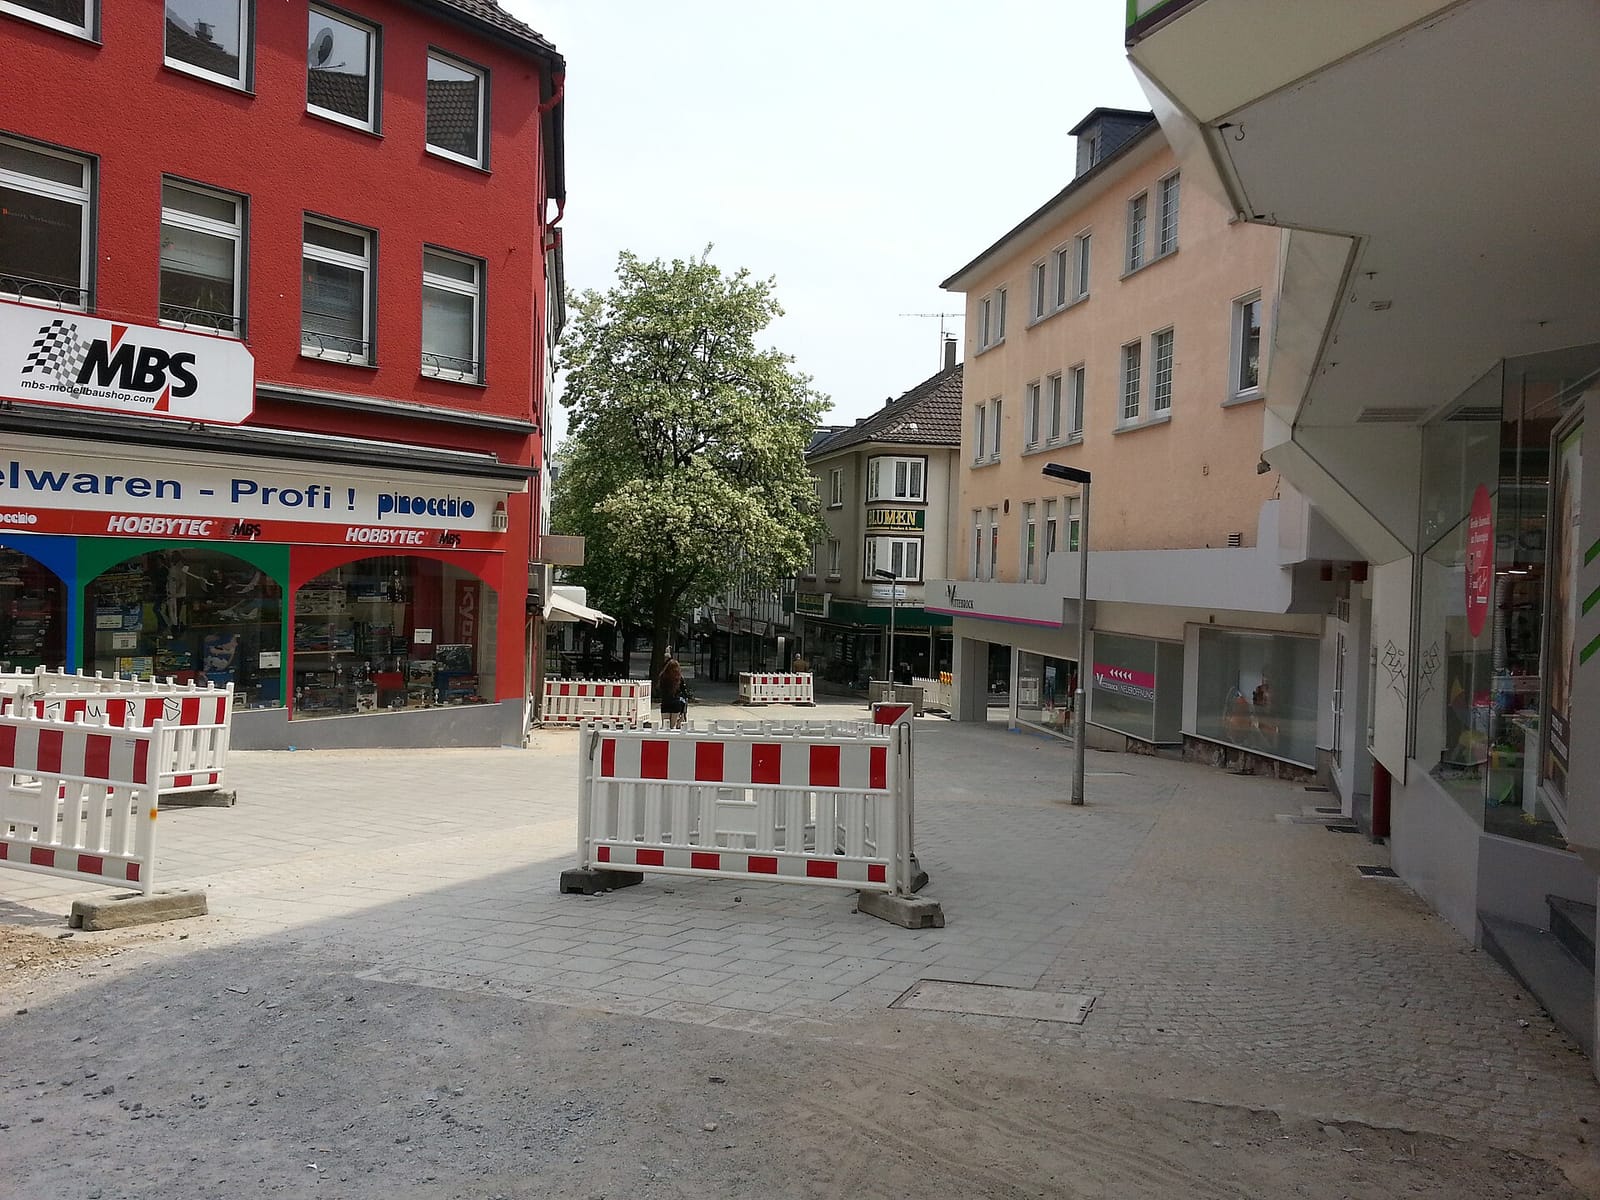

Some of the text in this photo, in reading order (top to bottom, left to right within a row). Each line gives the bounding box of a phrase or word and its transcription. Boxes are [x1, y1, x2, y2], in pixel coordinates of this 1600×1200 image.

[76, 339, 198, 398] MBS
[21, 379, 155, 404] mbs-modellbaushop.com
[0, 461, 182, 500] lwaren
[230, 478, 331, 509] Profi
[377, 492, 475, 520] pinocchio
[106, 515, 213, 536] HOBBYTEC
[232, 523, 261, 537] MBS
[345, 527, 425, 545] HOBBYTEC
[438, 533, 461, 545] MBS
